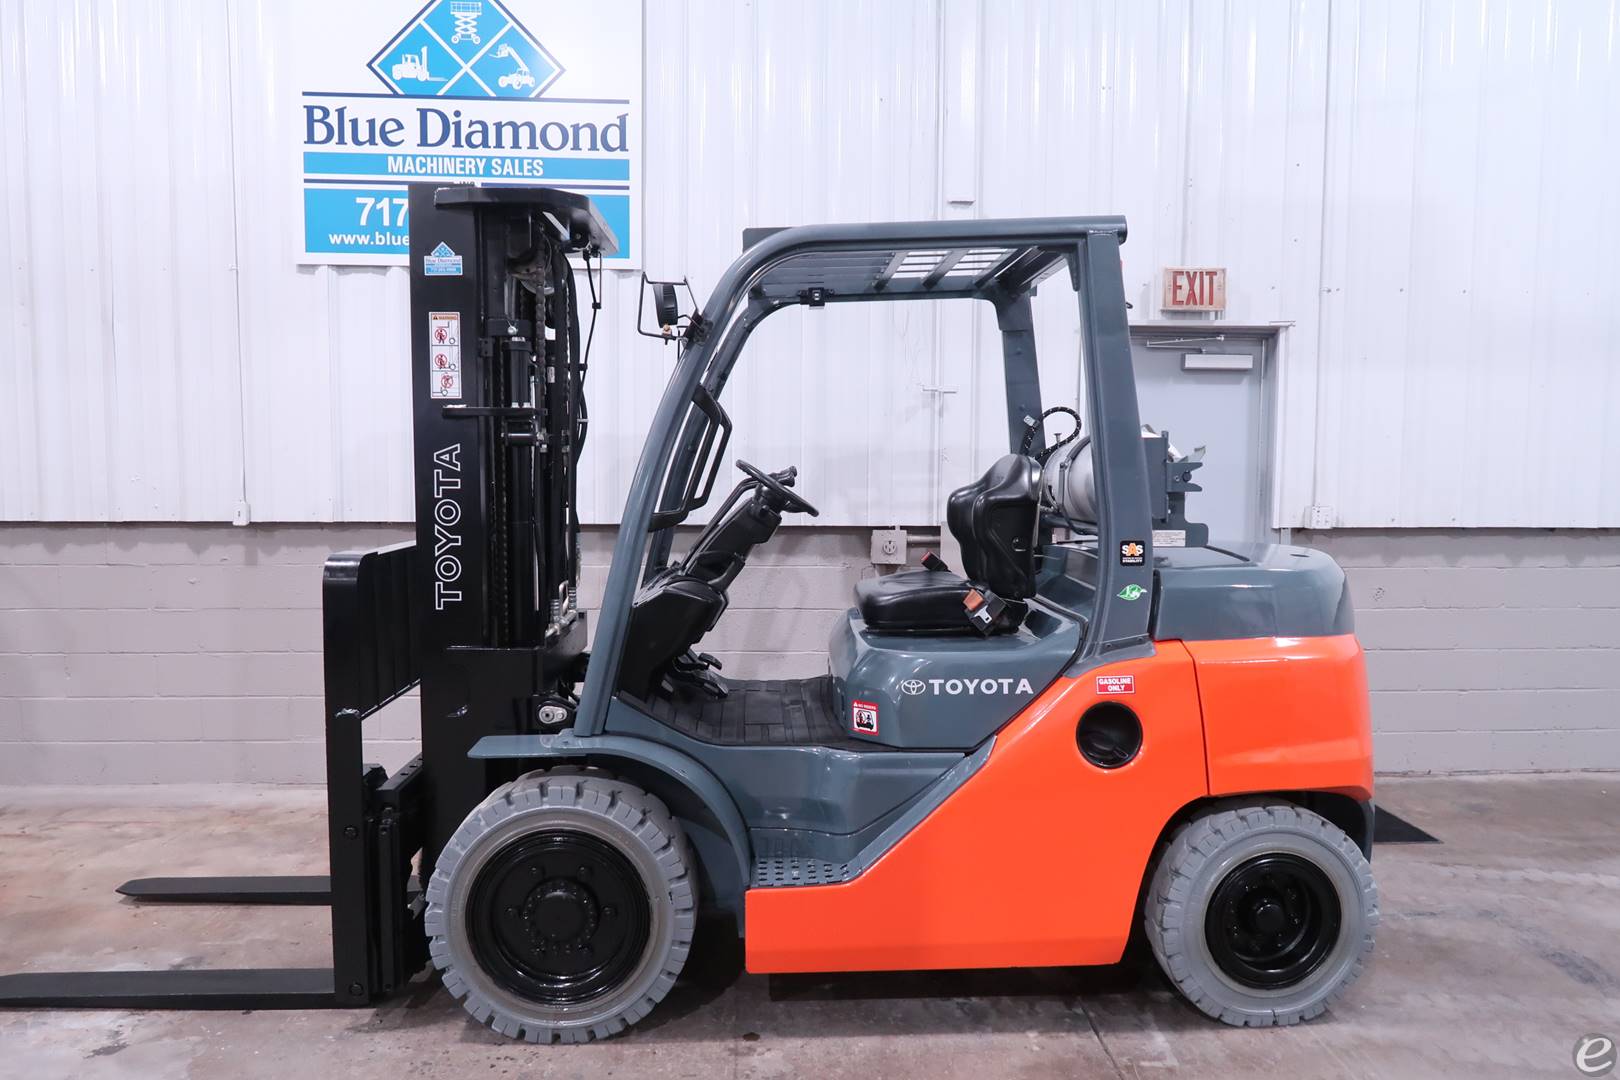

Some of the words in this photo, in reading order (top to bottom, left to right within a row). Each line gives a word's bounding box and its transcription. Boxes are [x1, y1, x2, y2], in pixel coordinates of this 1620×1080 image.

[303, 105, 405, 147] Blue
[416, 108, 630, 152] Diamond
[387, 156, 486, 174] MACHINERY
[491, 158, 544, 176] SALES
[1172, 271, 1217, 305] EXIT
[434, 443, 462, 610] TOYOTA
[1122, 543, 1143, 556] SAS
[929, 678, 1034, 695] TOYOTA
[1098, 677, 1131, 685] GASOLINE
[1107, 684, 1125, 692] ONLY
